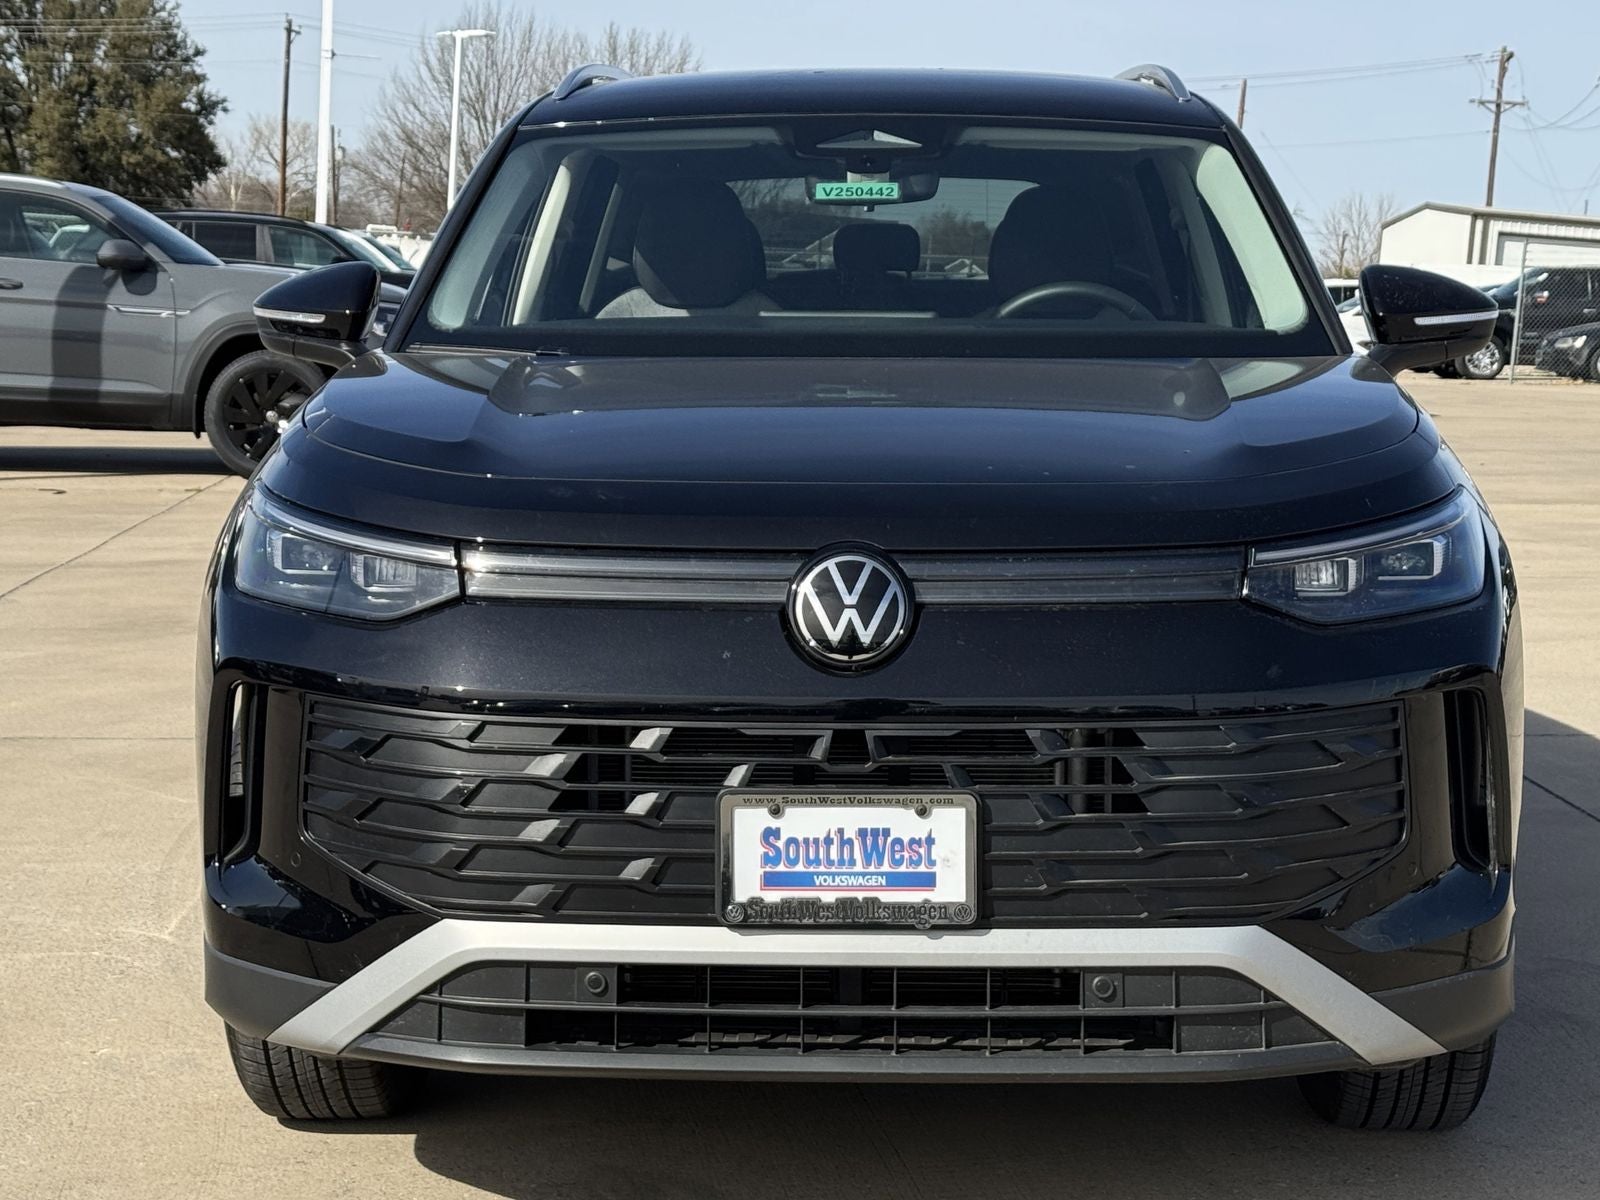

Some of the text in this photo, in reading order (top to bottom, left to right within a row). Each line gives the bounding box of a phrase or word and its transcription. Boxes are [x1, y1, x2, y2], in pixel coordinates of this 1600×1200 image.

[822, 186, 895, 197] V250442
[801, 558, 900, 650] VW
[742, 796, 954, 805] www.SouthWestVolkswagen.com
[814, 875, 886, 886] VOLKSWAGEN
